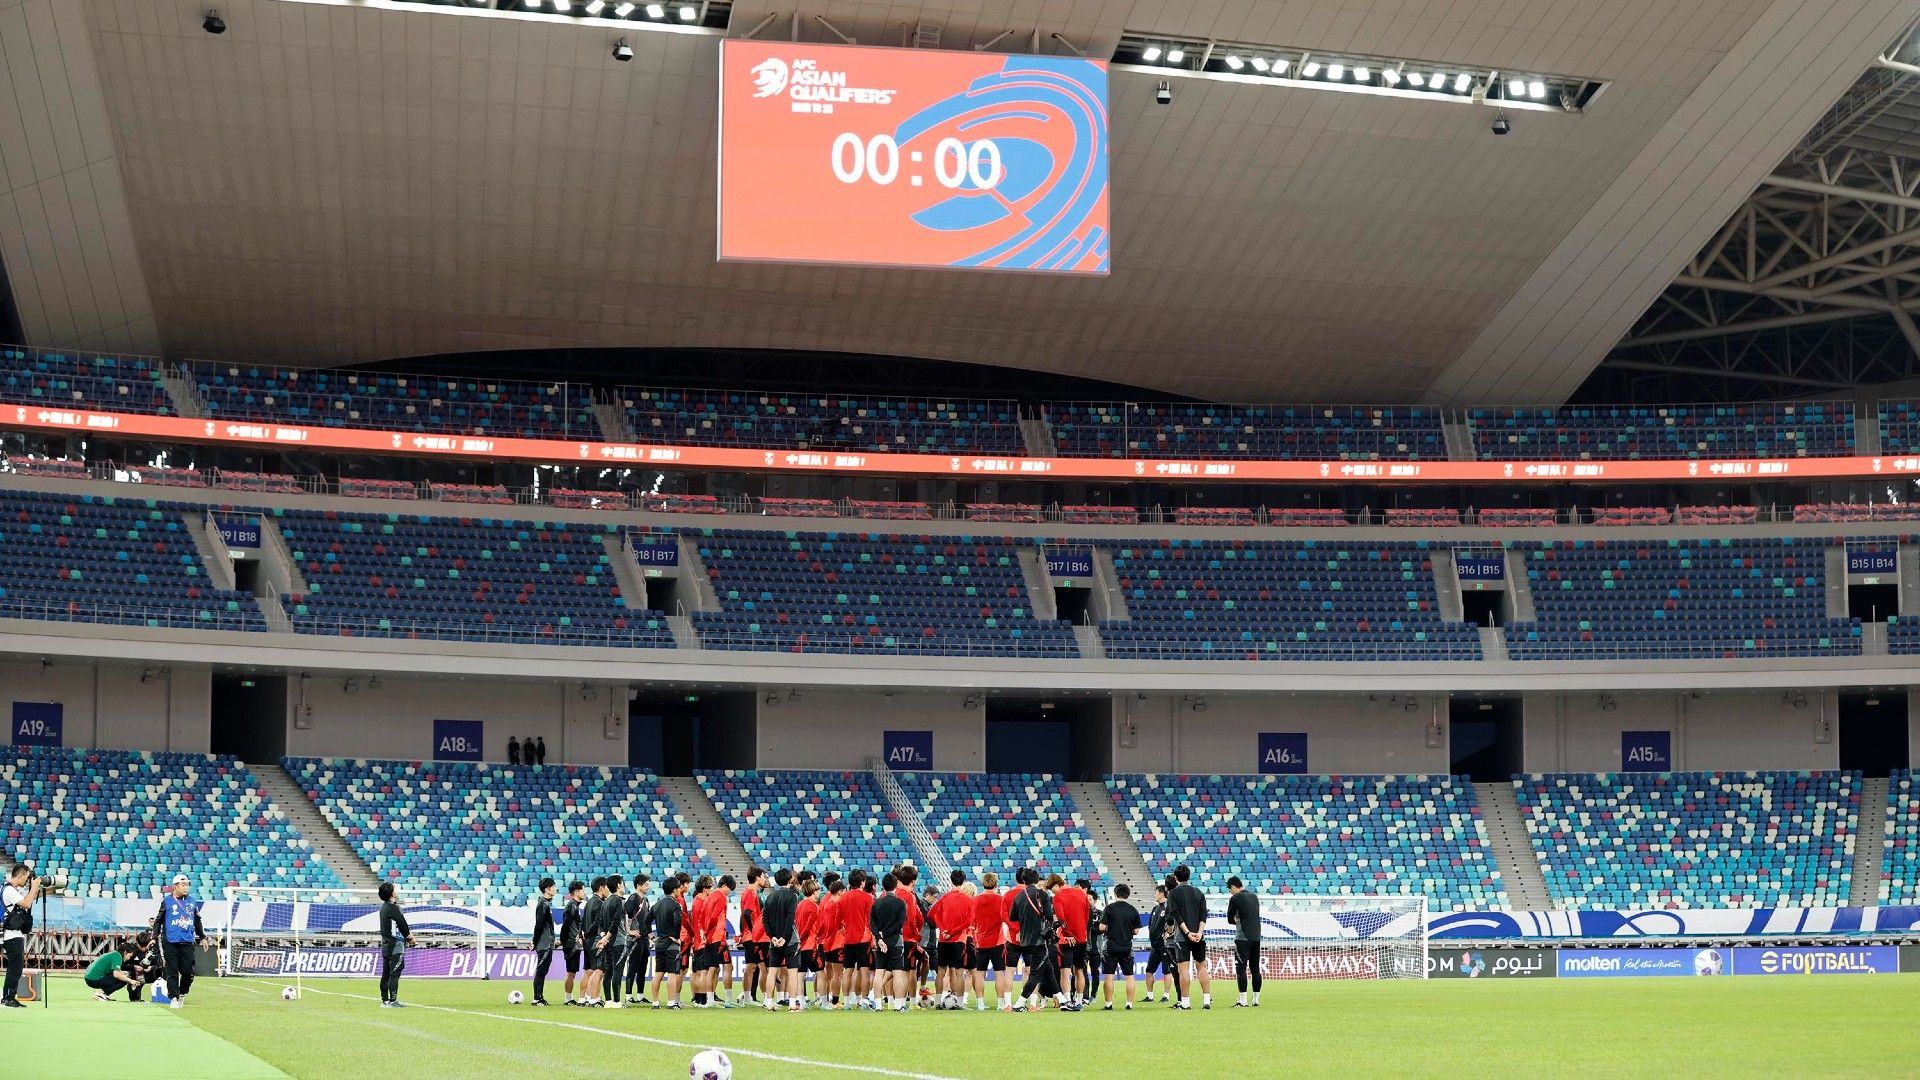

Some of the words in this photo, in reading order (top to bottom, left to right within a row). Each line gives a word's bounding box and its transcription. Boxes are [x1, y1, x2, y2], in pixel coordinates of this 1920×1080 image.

[792, 59, 816, 70] AFC
[790, 70, 846, 87] ASIAN
[238, 532, 256, 542] B18
[657, 551, 674, 560] B17
[1852, 559, 1869, 568] B15
[1876, 558, 1894, 568] B14
[1047, 561, 1064, 570] B17
[1072, 562, 1089, 572] B16
[1458, 565, 1475, 574] B16
[1482, 565, 1500, 574] B15
[18, 720, 44, 736] A19
[440, 736, 466, 752] A18
[890, 746, 914, 762] A17
[1264, 748, 1290, 763] A16
[1628, 746, 1654, 762] A15
[241, 954, 279, 968] MATCH
[285, 952, 372, 972] PREDICTOR
[1281, 956, 1376, 974] AIRWAYS
[1492, 953, 1542, 975] نيوم
[1565, 956, 1619, 972] molten
